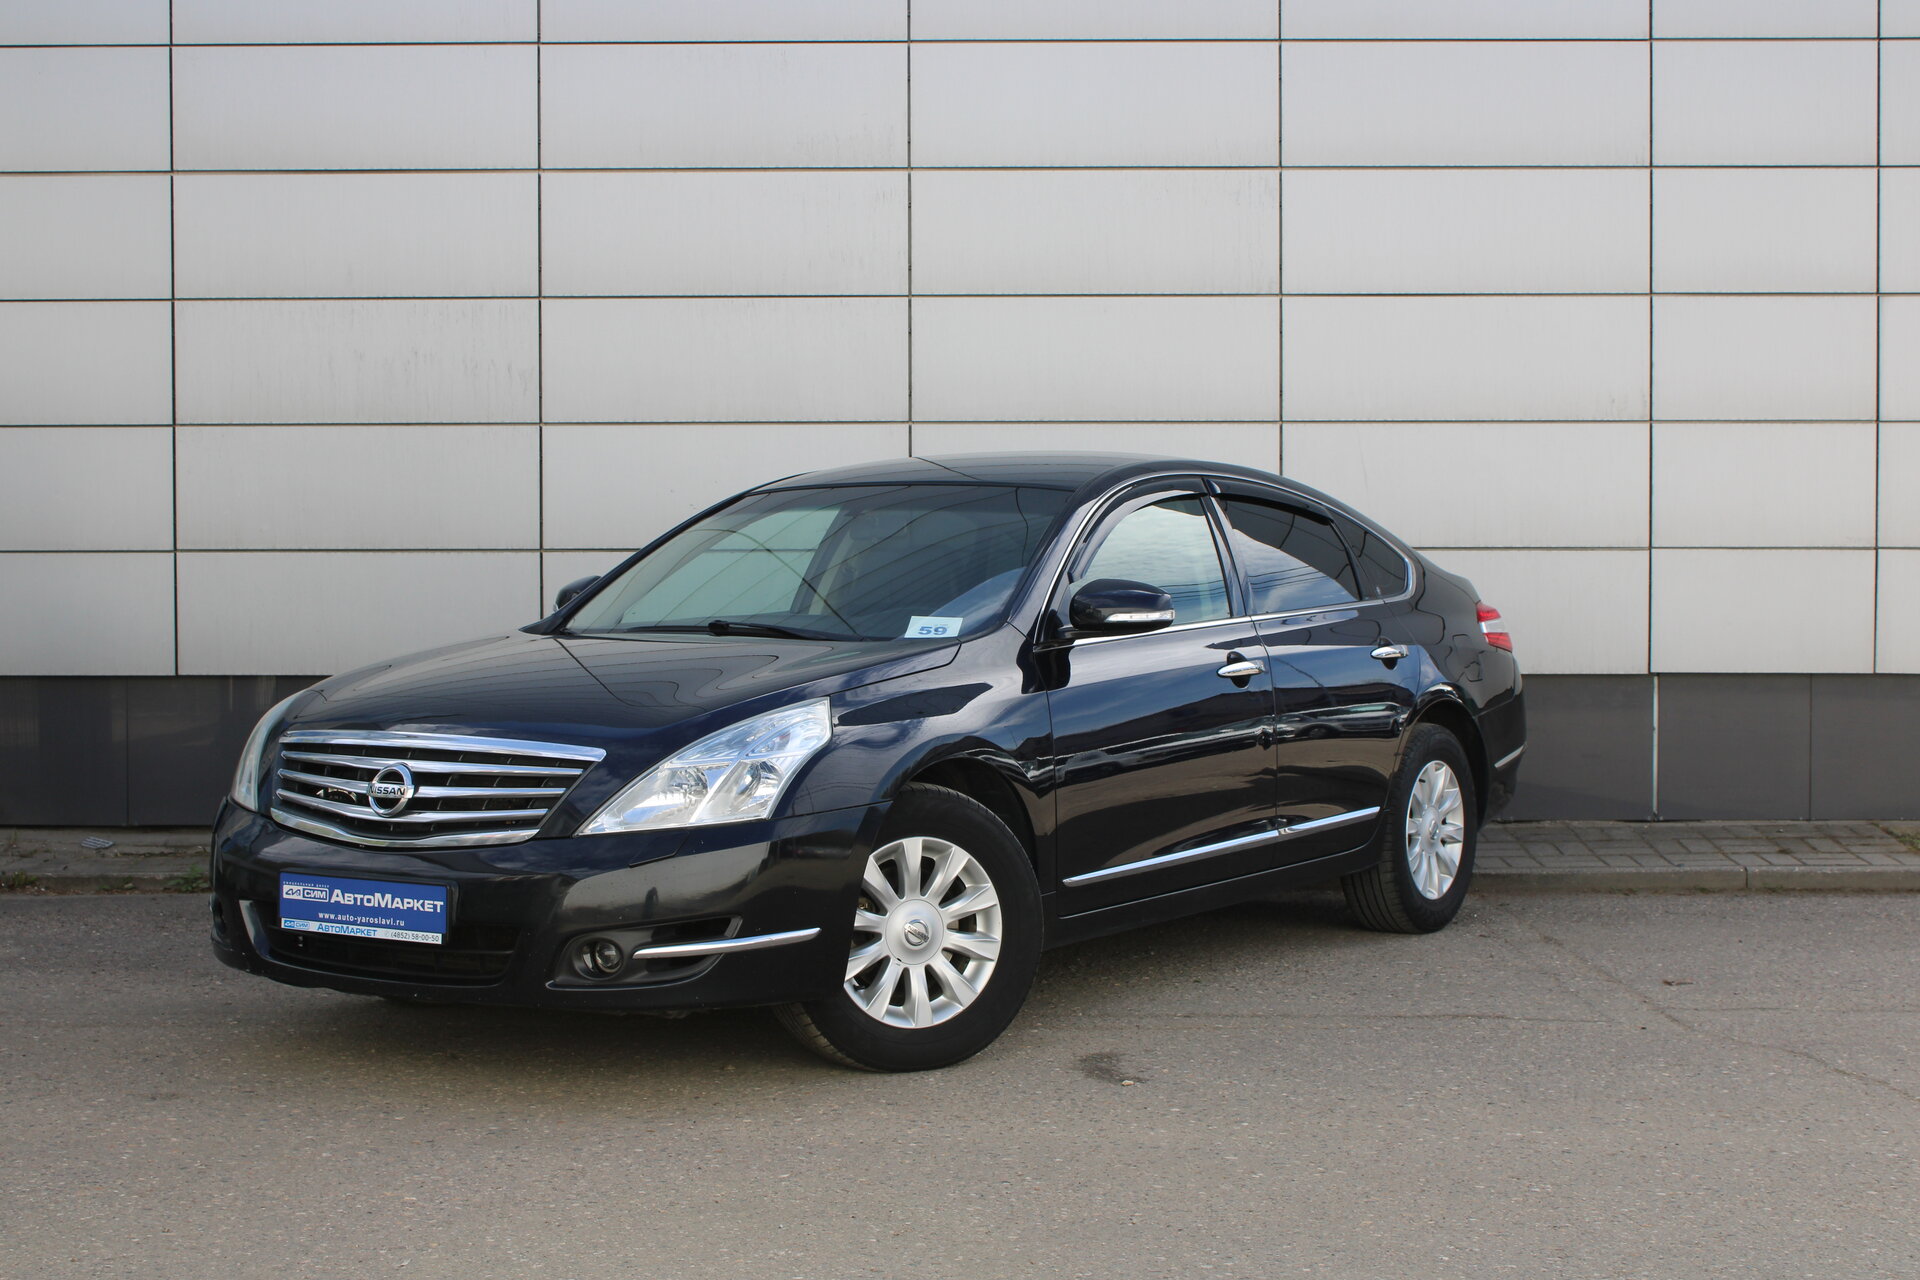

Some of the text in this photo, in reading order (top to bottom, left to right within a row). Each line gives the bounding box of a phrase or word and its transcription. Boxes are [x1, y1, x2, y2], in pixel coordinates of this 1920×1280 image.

[918, 626, 947, 635] 59
[370, 785, 406, 796] NISSAN
[304, 889, 327, 899] СИМ
[318, 912, 405, 927] www.auto-yaroslavl.ru
